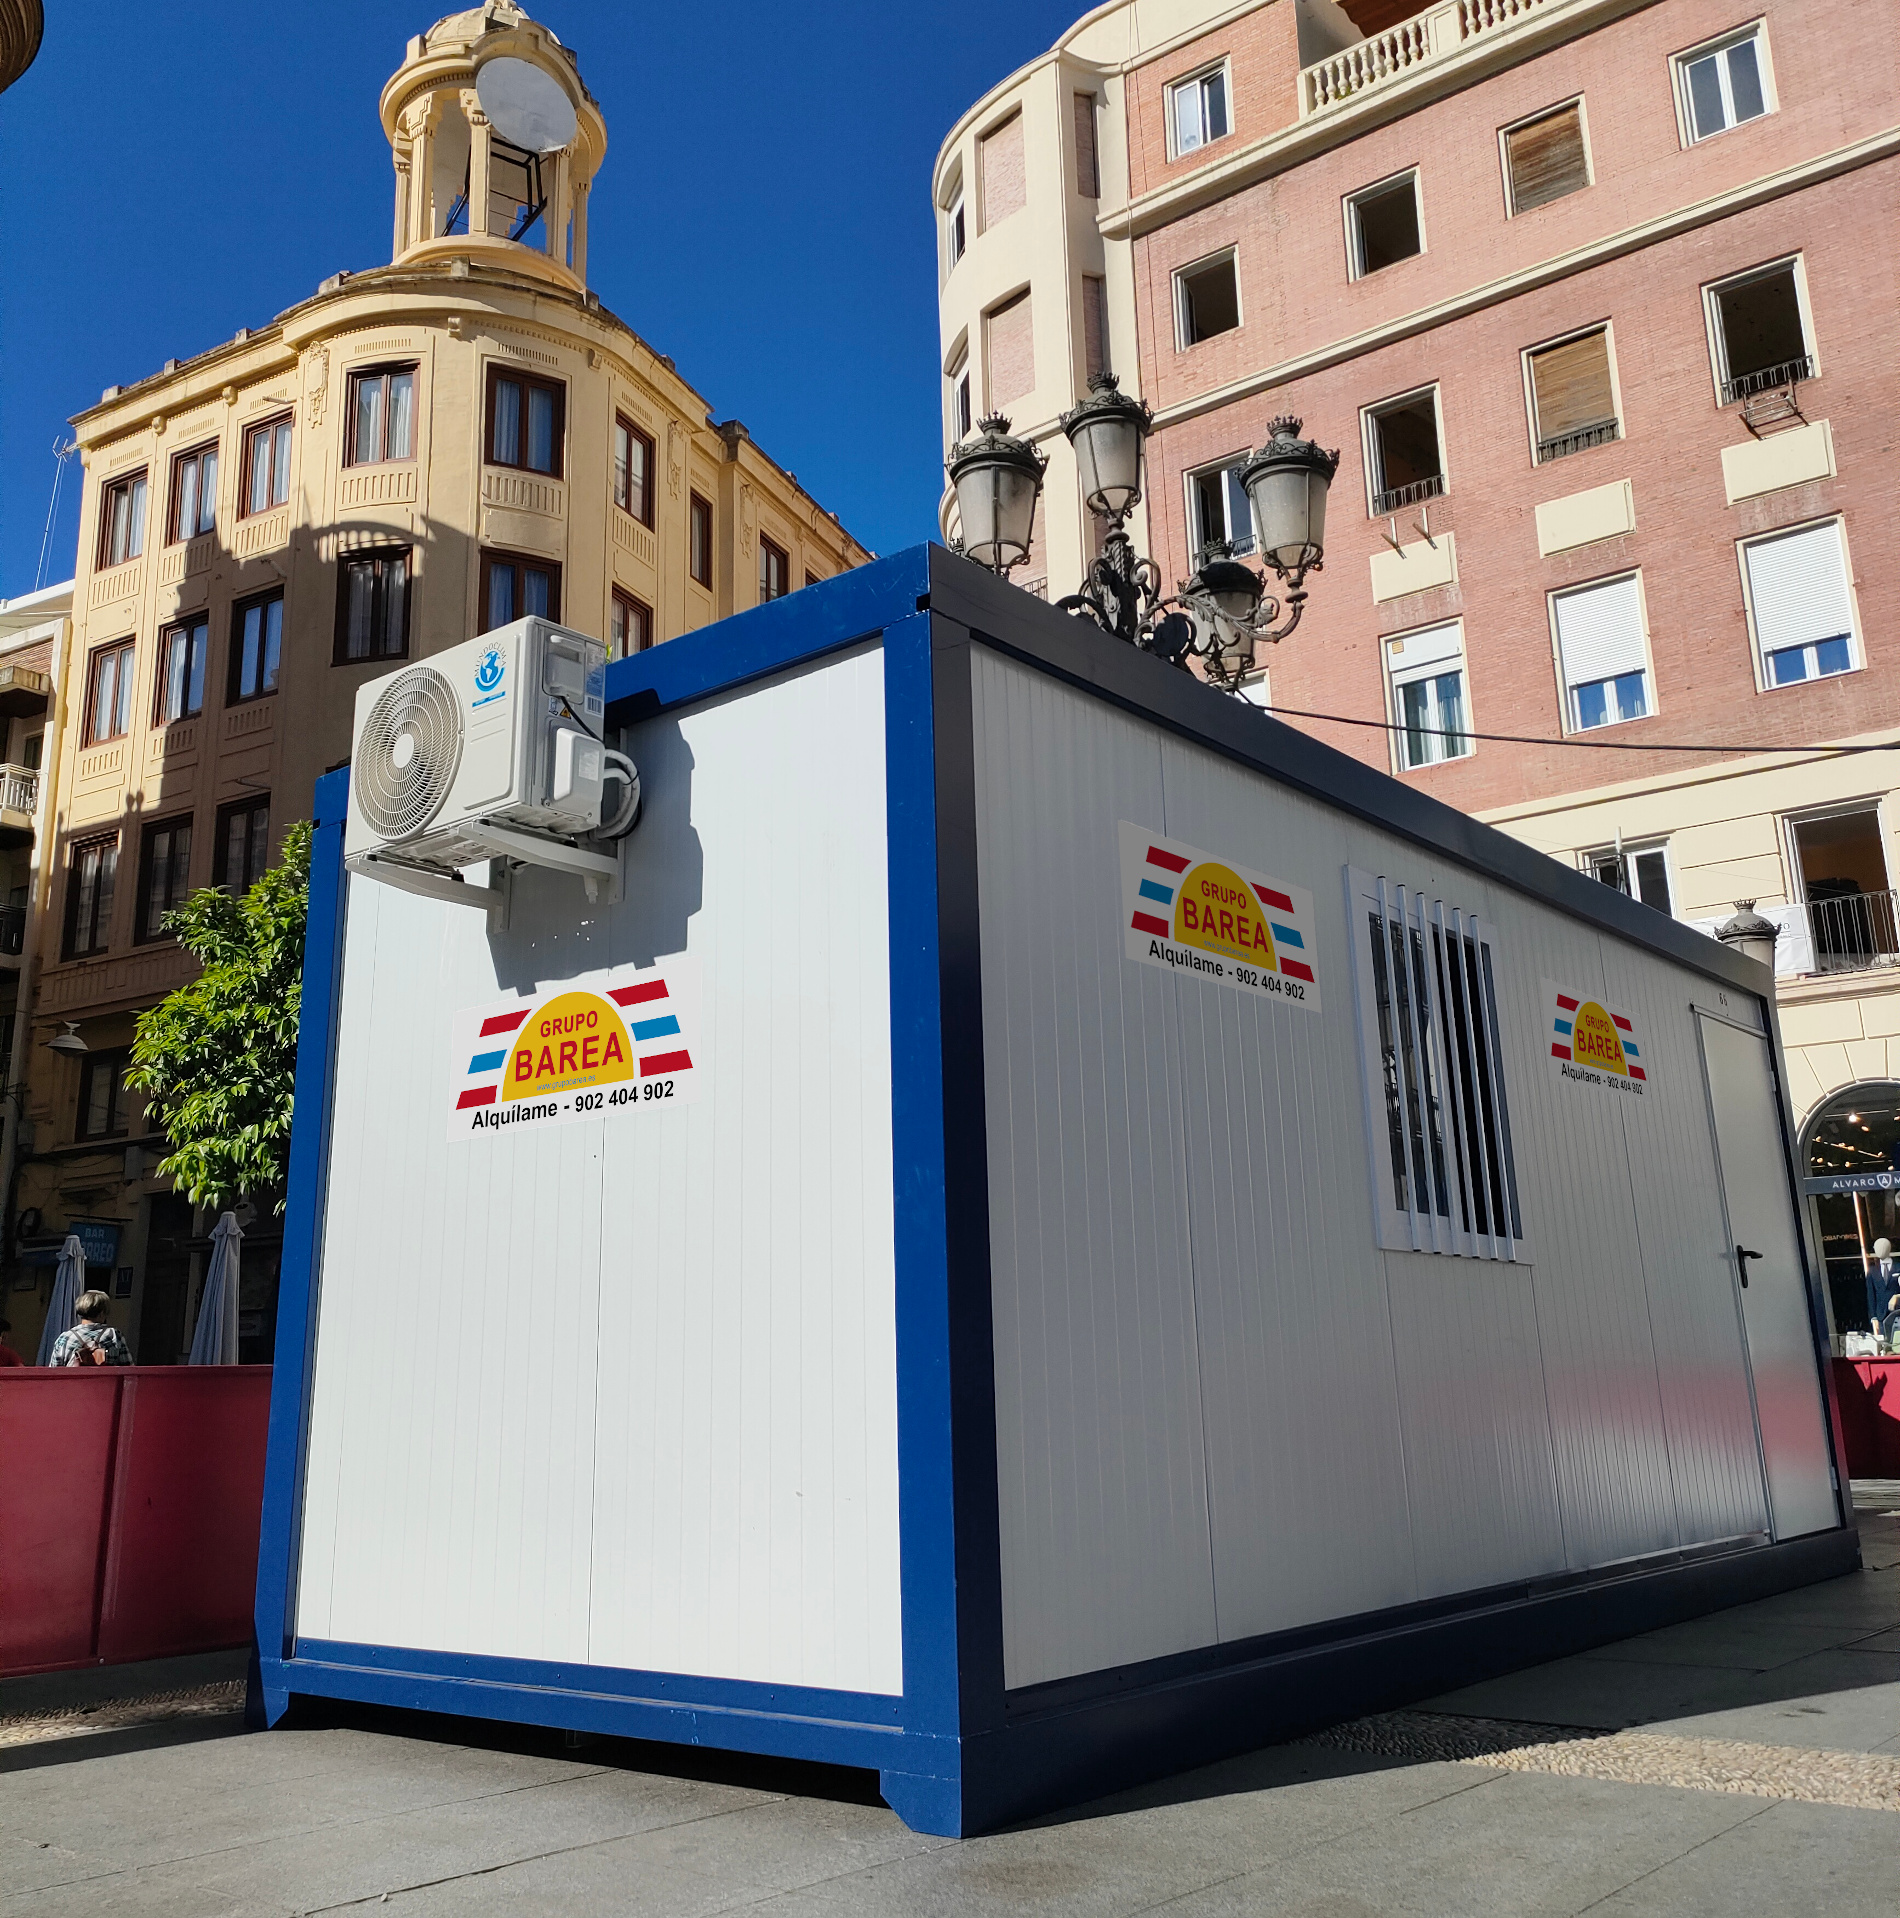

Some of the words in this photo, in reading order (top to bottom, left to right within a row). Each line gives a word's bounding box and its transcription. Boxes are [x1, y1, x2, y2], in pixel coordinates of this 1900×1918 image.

[474, 641, 507, 678] MUNDOCLIMA
[1201, 880, 1247, 910] GRUPO
[1182, 896, 1269, 953] BAREA
[1149, 939, 1223, 977] Alquílame
[1236, 967, 1258, 987] 902
[1261, 975, 1282, 994] 404
[1284, 982, 1305, 1001] 902
[540, 1010, 598, 1038] GRUPO
[1585, 1014, 1610, 1033] GRUPO
[515, 1031, 624, 1083] BAREA
[1577, 1028, 1623, 1063] BAREA
[1607, 1075, 1620, 1089] 902
[1620, 1078, 1632, 1092] 404
[1632, 1081, 1644, 1095] 902
[471, 1101, 558, 1130] Alquílame
[575, 1092, 604, 1113] 902
[608, 1086, 639, 1106] 404
[643, 1080, 674, 1100] 902
[1832, 1178, 1875, 1189] ALVARO
[85, 1227, 105, 1239] BAR
